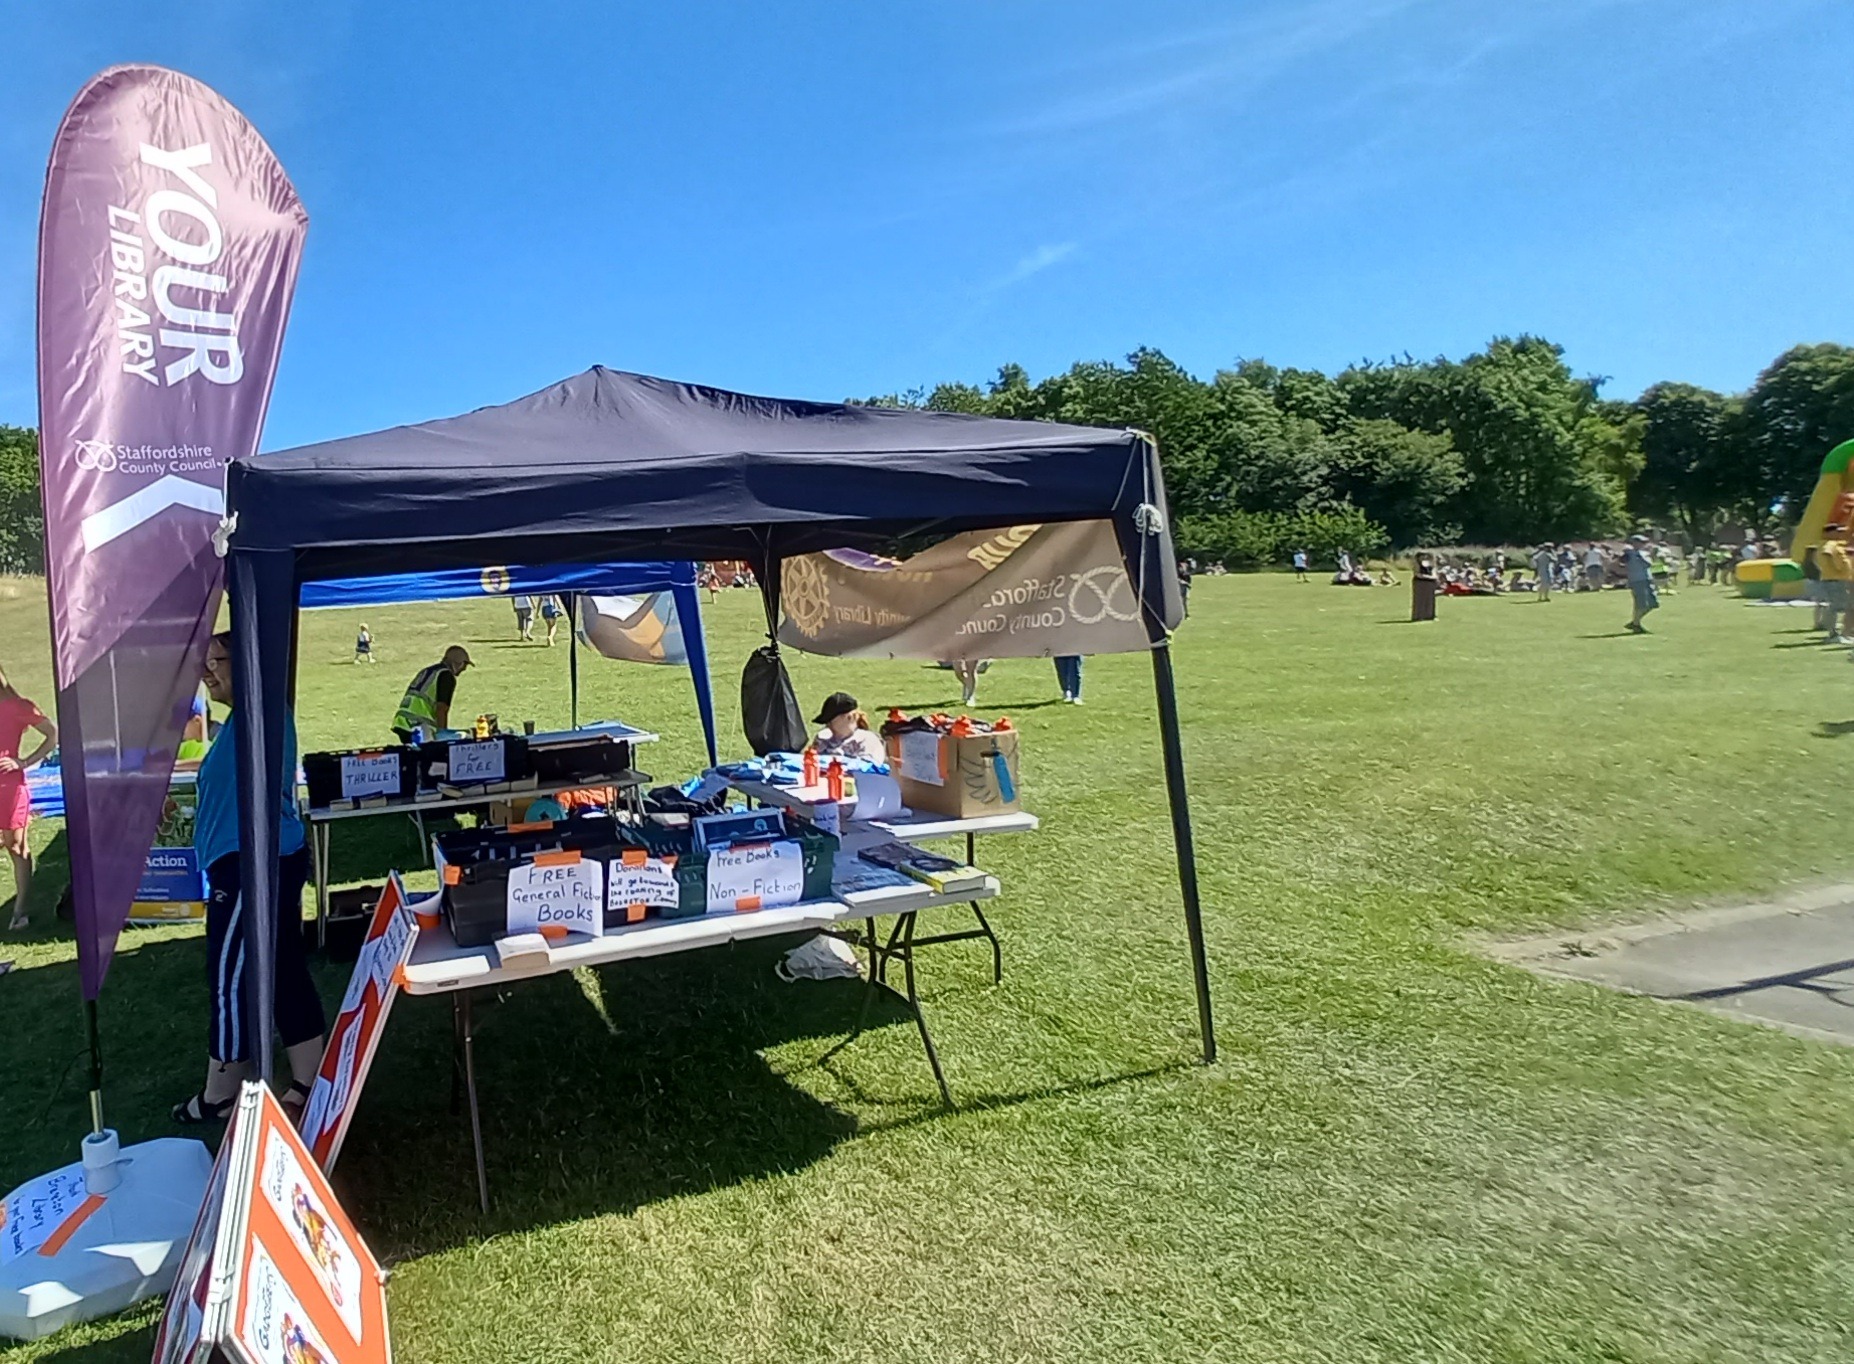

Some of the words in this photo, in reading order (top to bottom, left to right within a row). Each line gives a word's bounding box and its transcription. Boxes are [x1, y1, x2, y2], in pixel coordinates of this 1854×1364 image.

[139, 142, 244, 387] YOUR
[107, 204, 159, 387] LIBRARY
[117, 443, 212, 460] Staffordshire
[119, 461, 165, 476] County
[169, 458, 216, 472] Council
[455, 760, 493, 775] FREE
[717, 851, 742, 868] Free
[529, 866, 577, 884] FREE
[512, 884, 566, 903] General
[710, 881, 737, 900] Non
[753, 878, 801, 896] Fiction
[537, 902, 594, 922] Books
